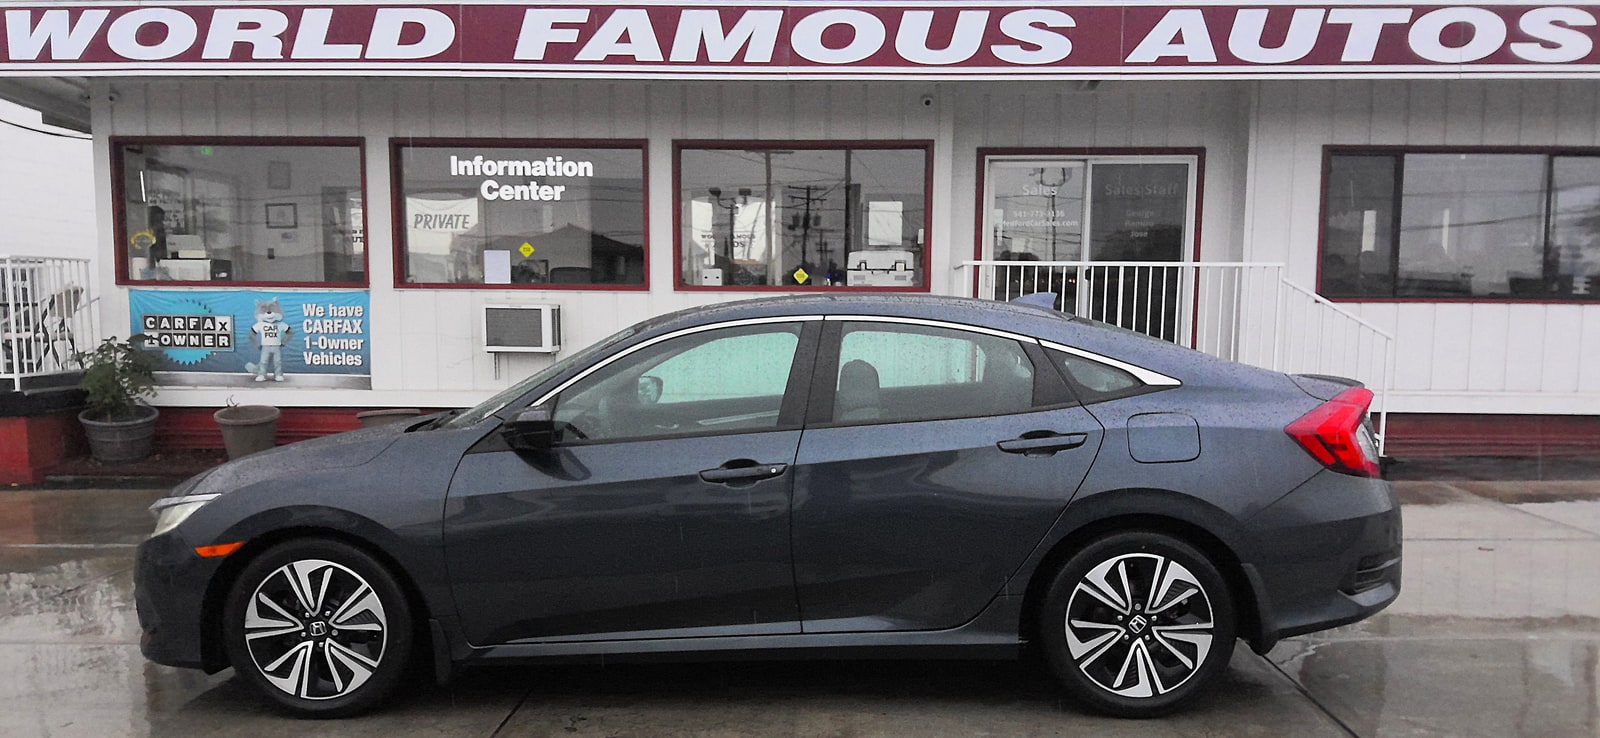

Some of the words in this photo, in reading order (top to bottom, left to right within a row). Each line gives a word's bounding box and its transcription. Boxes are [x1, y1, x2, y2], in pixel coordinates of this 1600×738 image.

[5, 8, 456, 60] WORLD
[513, 9, 1076, 64] FAMOUS
[1124, 7, 1597, 63] AUTOS
[450, 155, 593, 177] Information
[480, 179, 565, 201] Center
[1022, 185, 1057, 196] Sales
[1105, 184, 1140, 196] Sales
[413, 213, 470, 230] PRIVATE
[303, 304, 325, 317] We
[329, 304, 364, 317] have
[145, 317, 228, 331] CARFAX
[303, 319, 363, 333] CARFAX
[160, 335, 230, 346] OWNER
[304, 336, 364, 350] 1-Owner
[303, 351, 363, 366] Vehicles
